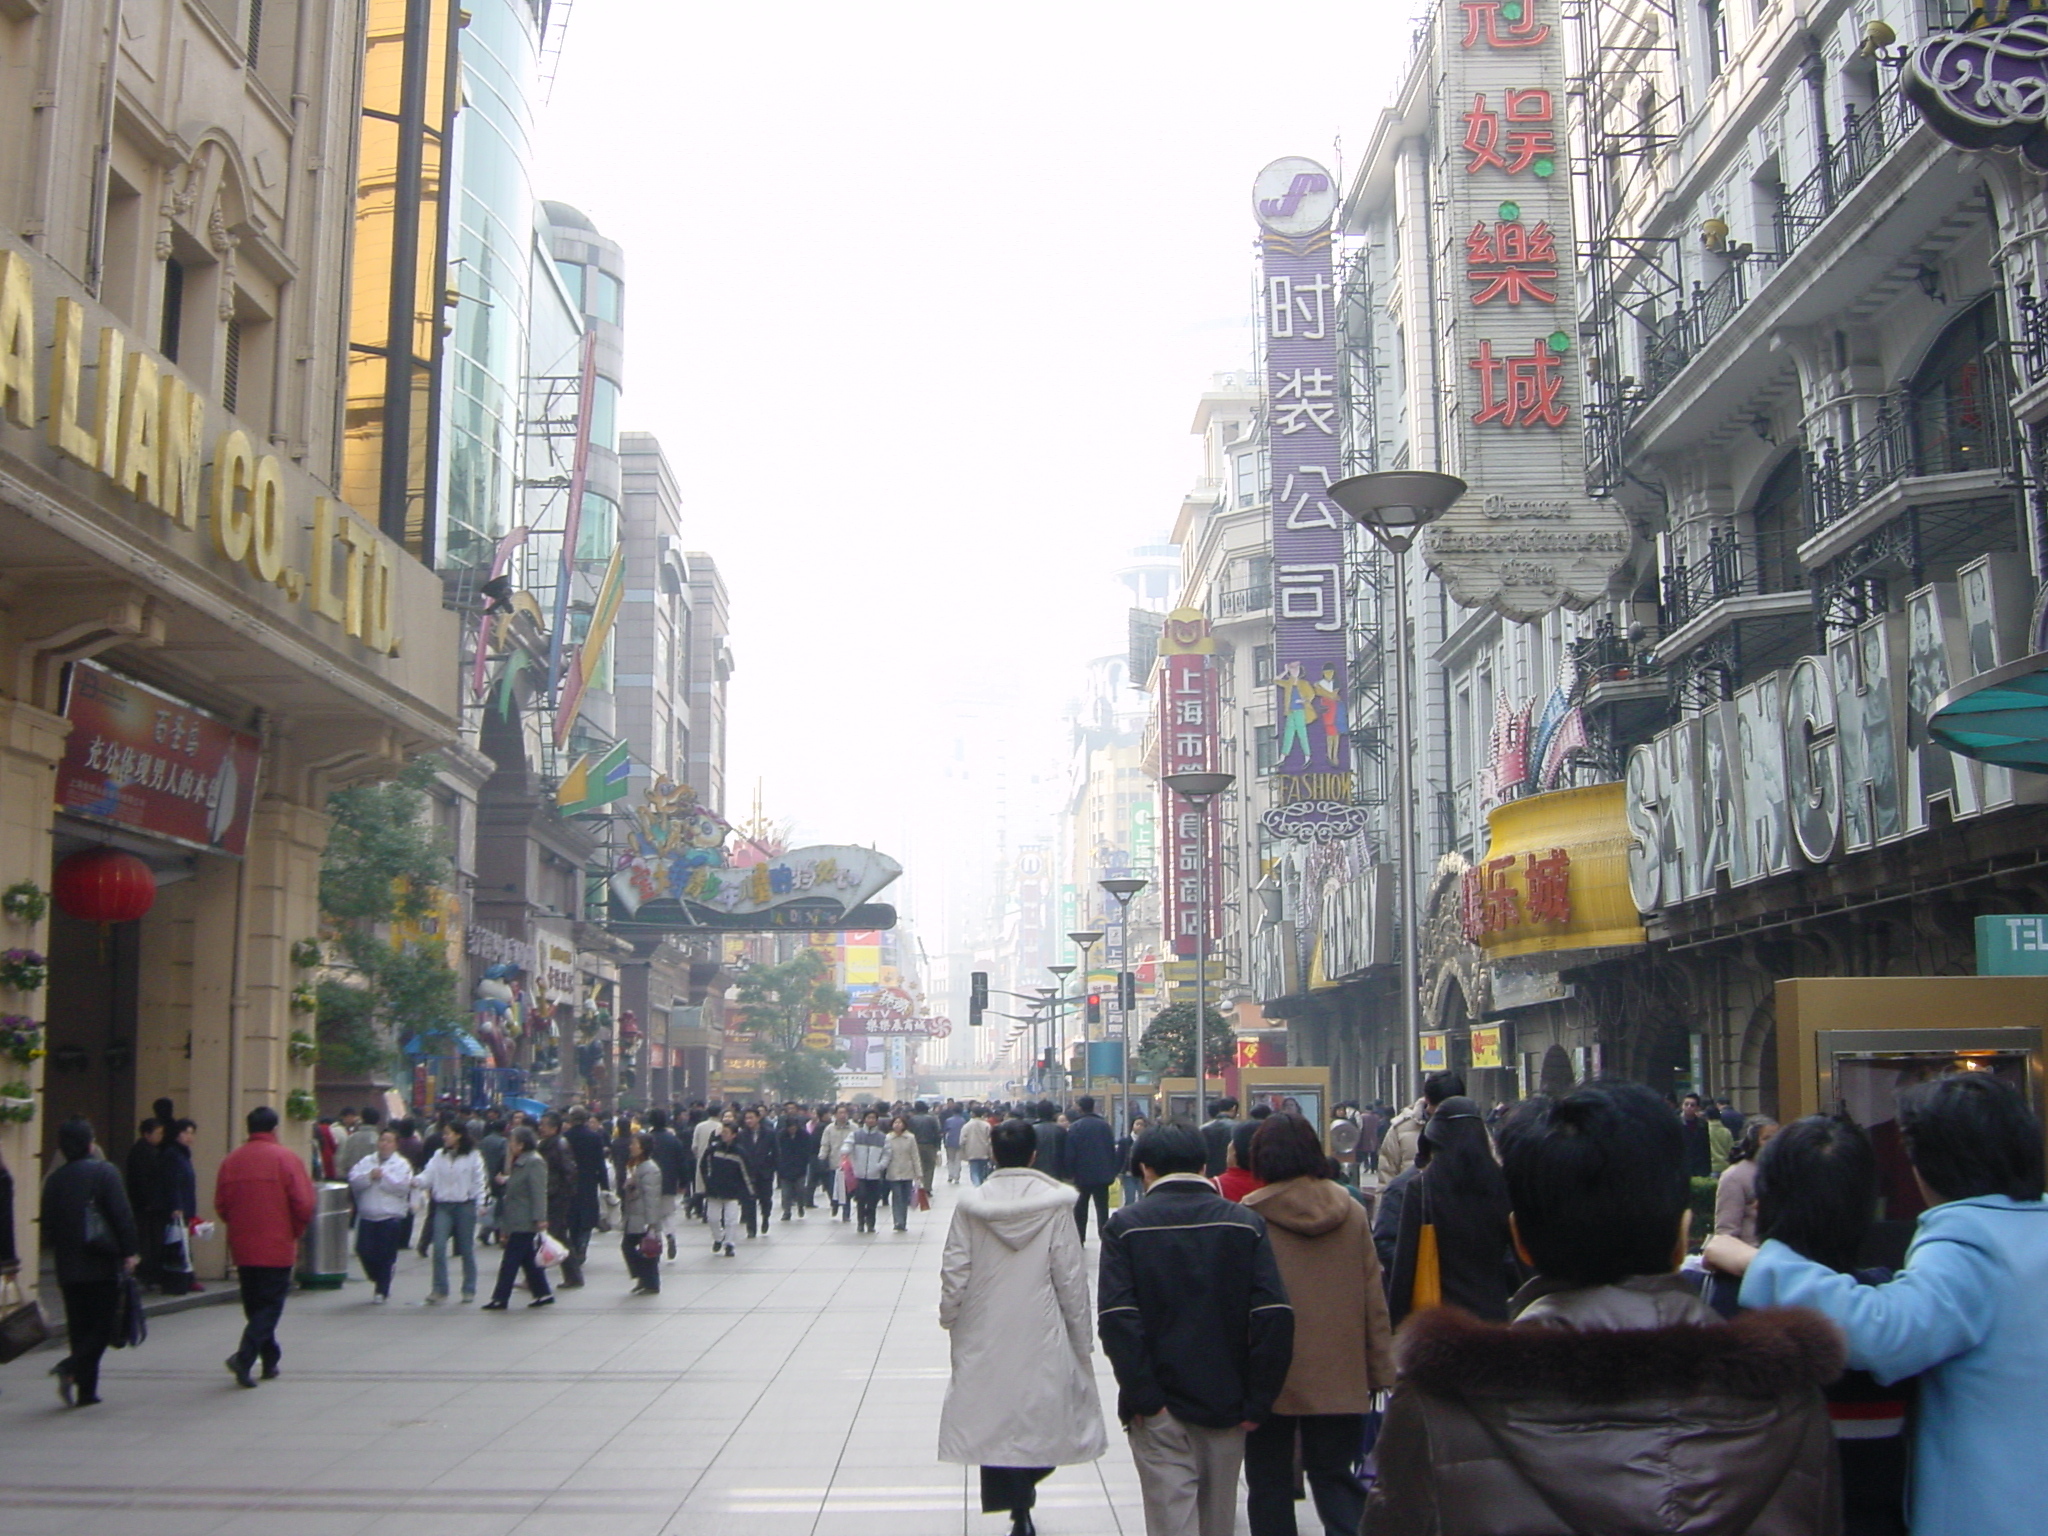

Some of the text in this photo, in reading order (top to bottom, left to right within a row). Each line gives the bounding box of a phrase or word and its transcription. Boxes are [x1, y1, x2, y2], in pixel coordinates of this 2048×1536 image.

[1270, 273, 1342, 631] 时装公司
[1278, 771, 1353, 806] FASHION
[1627, 553, 2016, 912] SHANGHAI
[857, 1009, 890, 1023] KTV
